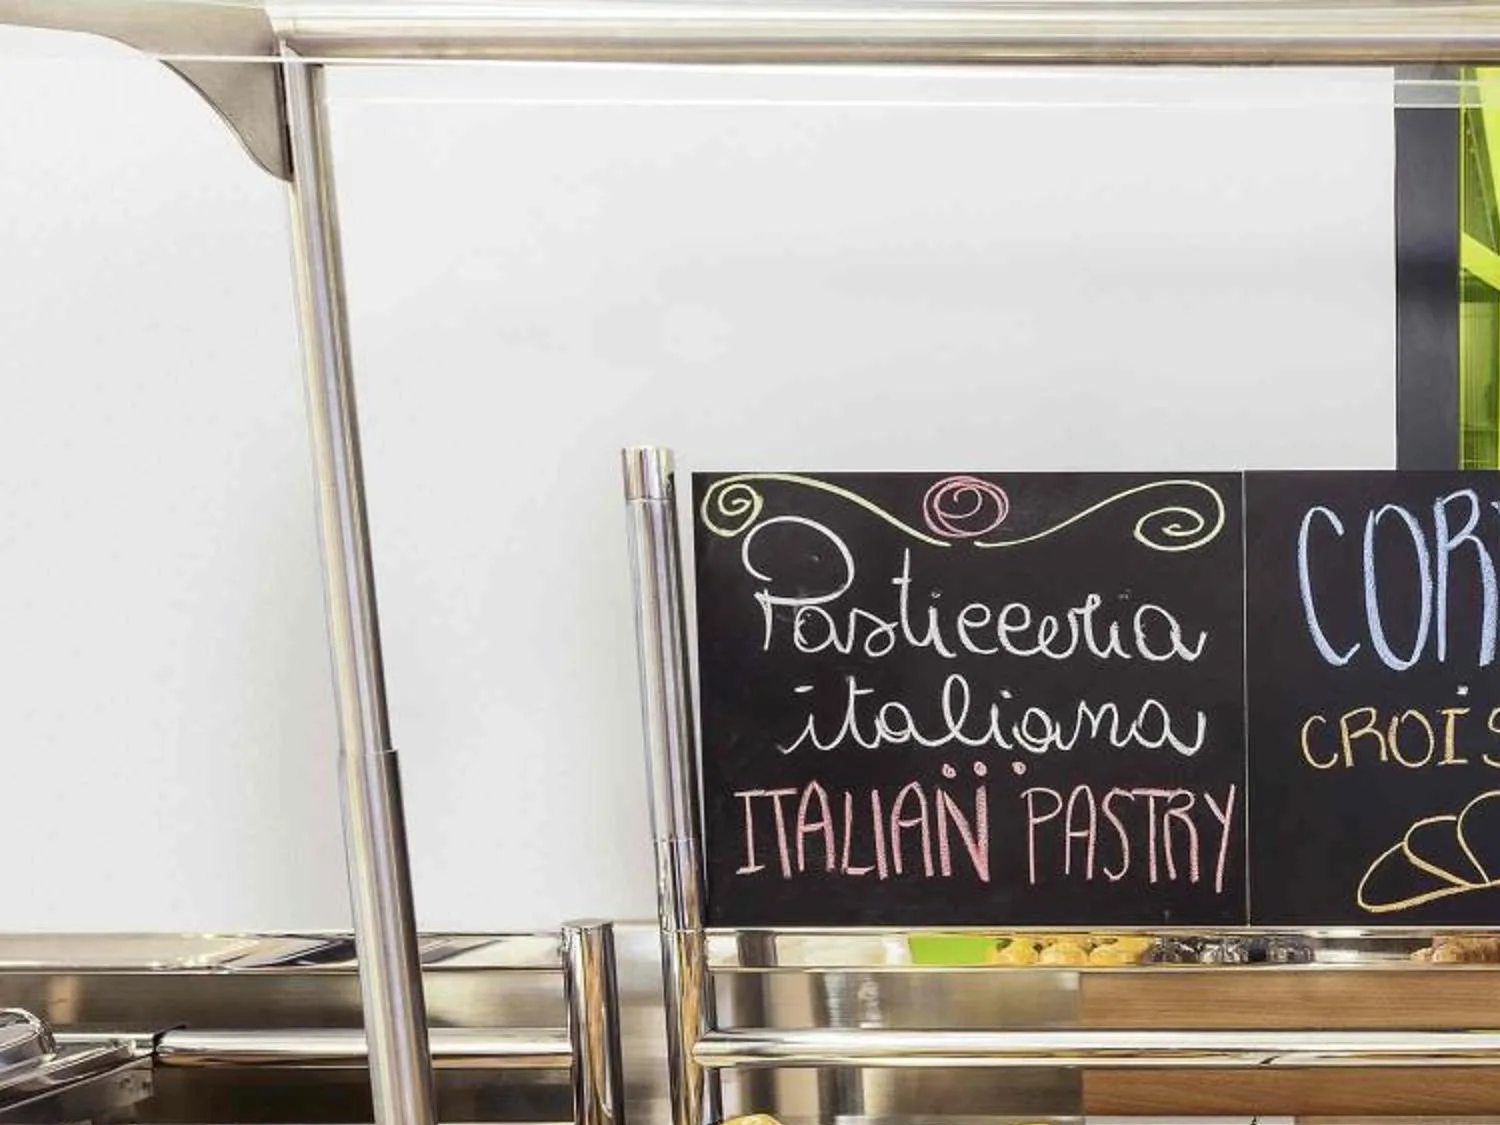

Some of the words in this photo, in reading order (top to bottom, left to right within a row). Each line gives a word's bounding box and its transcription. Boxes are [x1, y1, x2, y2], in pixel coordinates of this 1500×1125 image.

[776, 673, 1207, 756] italiana
[733, 779, 990, 883] ITALIAN
[1021, 783, 1237, 894] PASTRY
